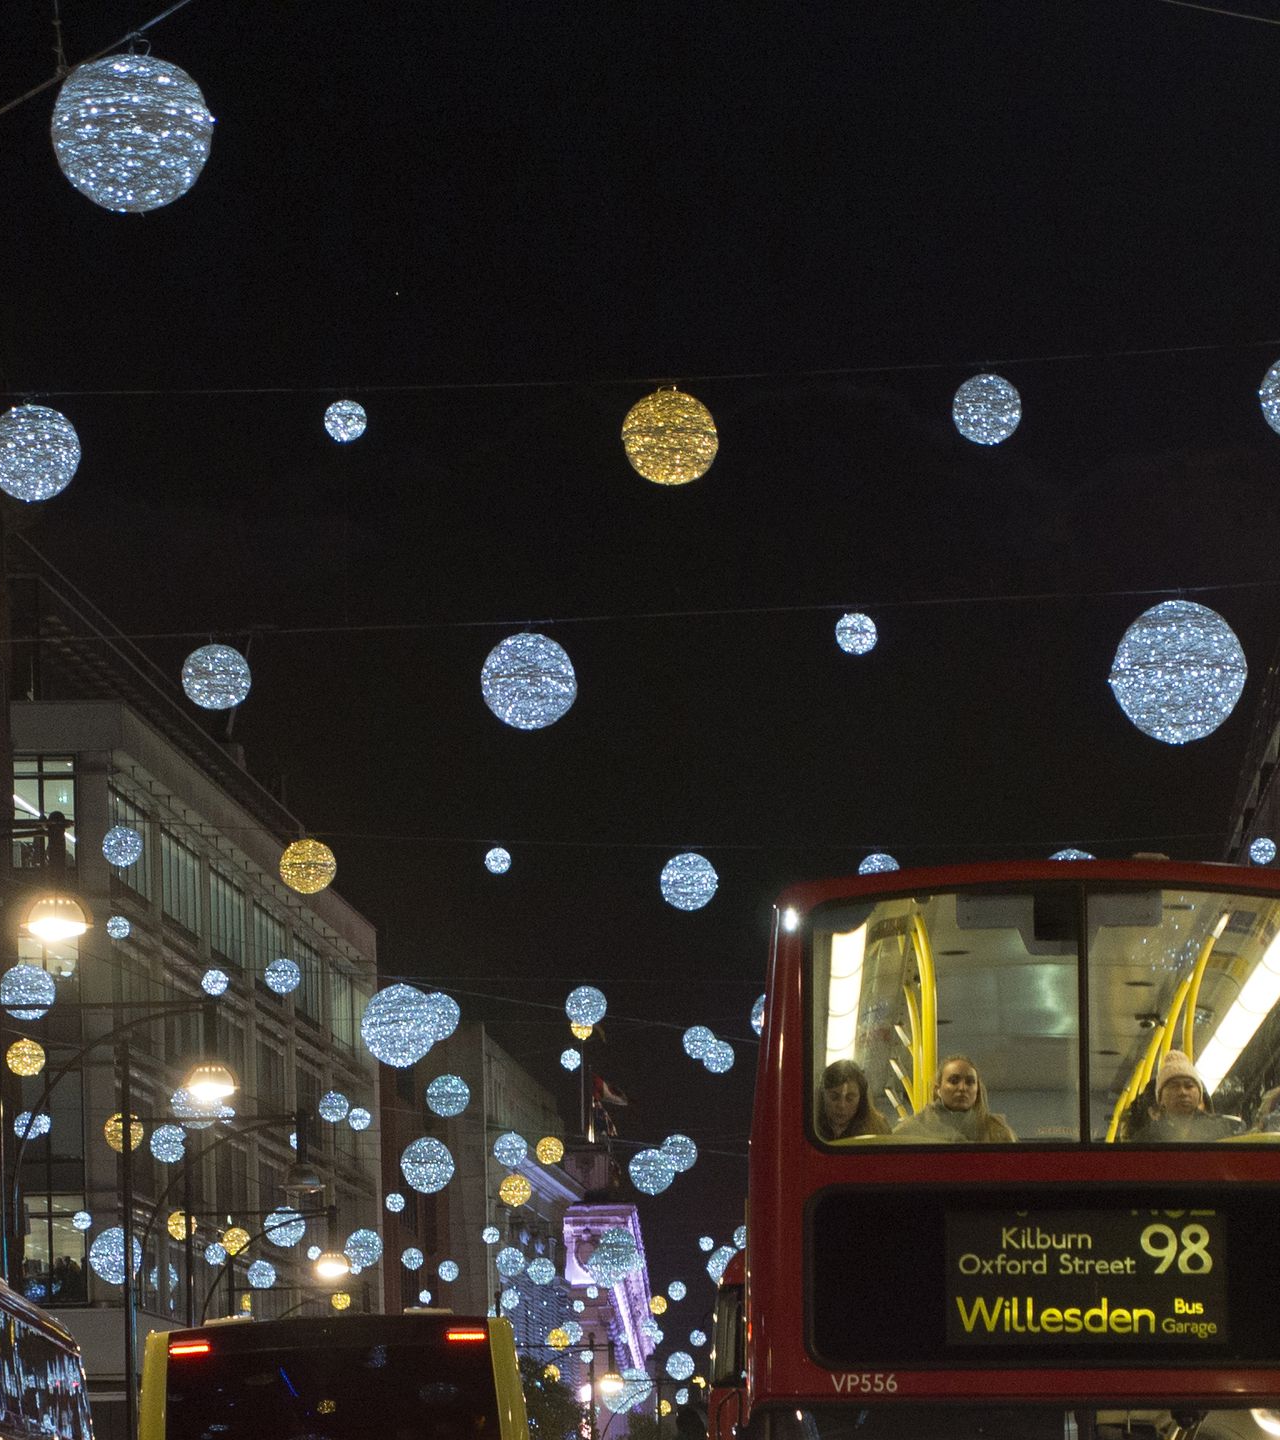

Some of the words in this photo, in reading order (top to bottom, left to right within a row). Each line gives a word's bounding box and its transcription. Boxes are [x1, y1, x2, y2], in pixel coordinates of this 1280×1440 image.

[1001, 1226, 1093, 1250] Kilburn
[1139, 1222, 1214, 1275] 98
[958, 1252, 1049, 1275] Oxford
[1058, 1253, 1137, 1275] Street
[955, 1296, 1157, 1334] Willesden
[1173, 1297, 1205, 1316] Bus
[1161, 1317, 1218, 1339] Garage
[831, 1373, 899, 1393] VP556
